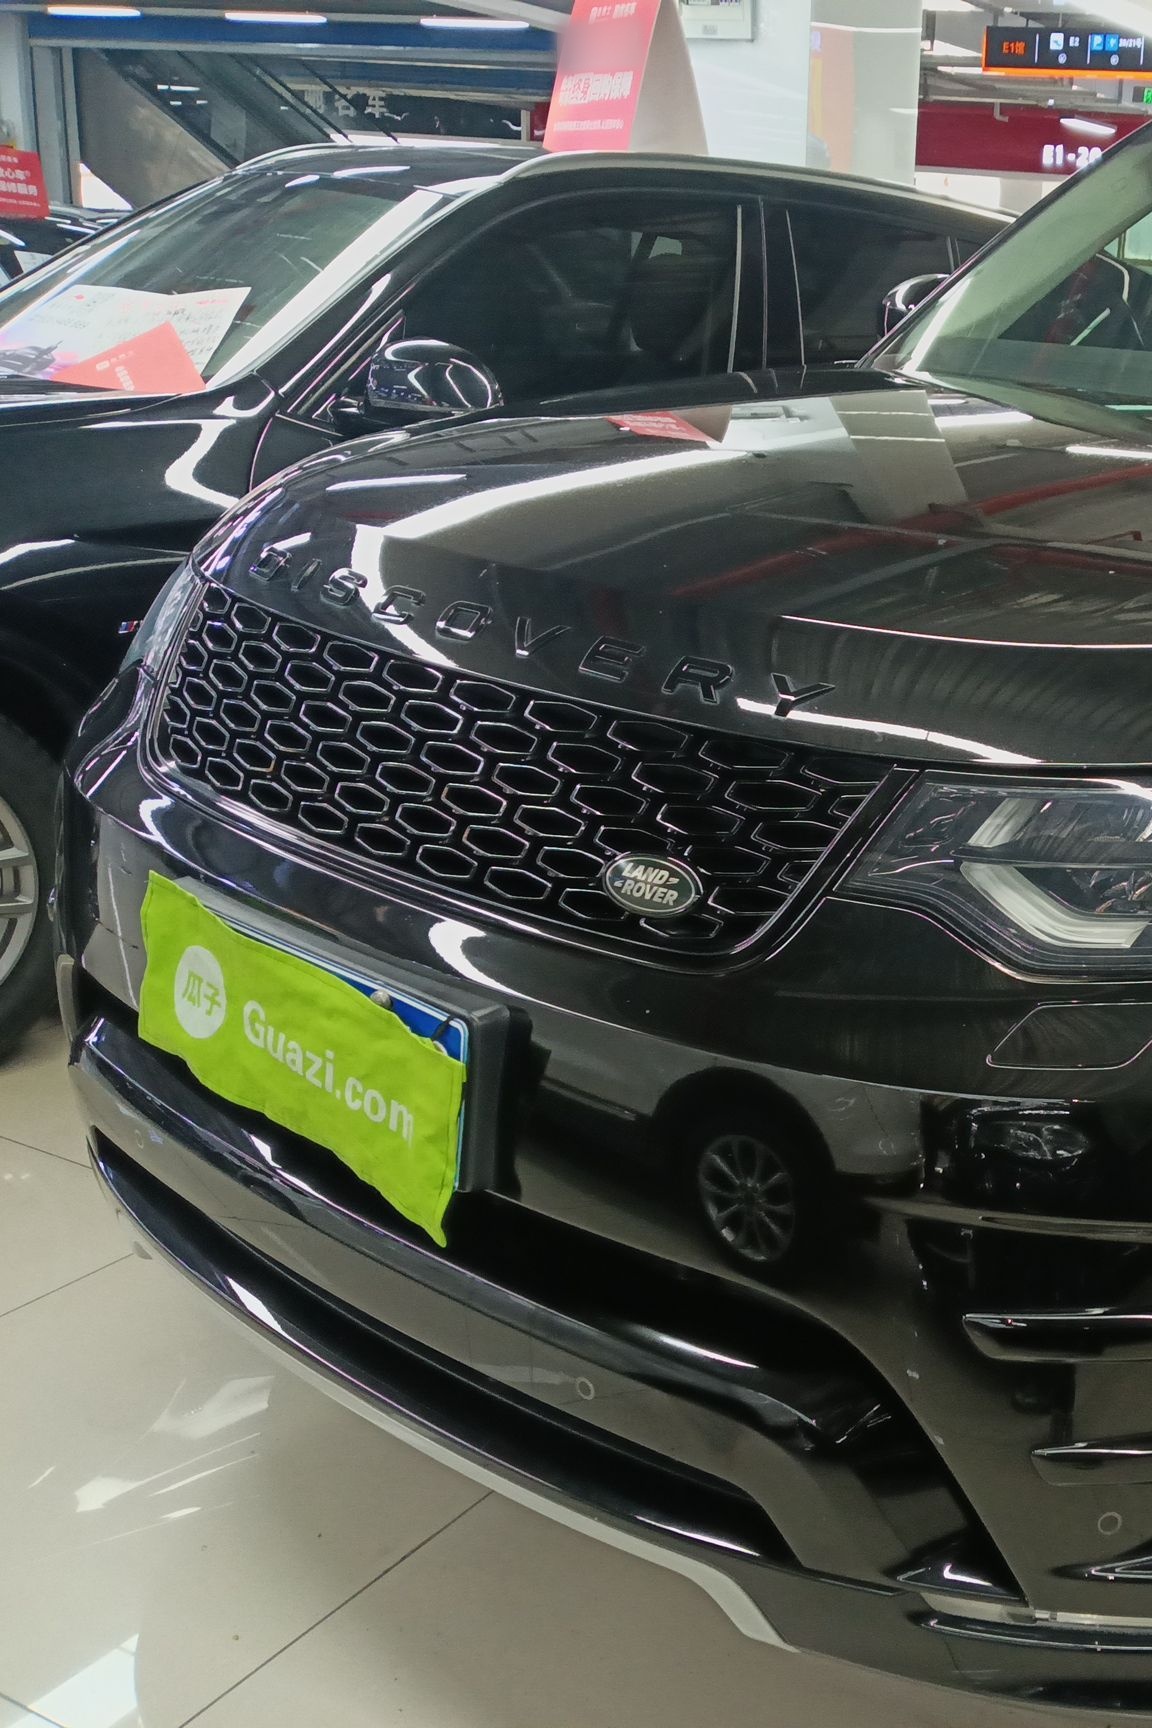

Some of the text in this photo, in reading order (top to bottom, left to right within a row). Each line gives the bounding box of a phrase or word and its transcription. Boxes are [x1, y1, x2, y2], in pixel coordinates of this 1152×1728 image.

[248, 545, 837, 720] DISCOVERY
[621, 862, 670, 885] LAND
[621, 880, 679, 906] ROVER
[183, 970, 223, 1017] 瓜子
[242, 1000, 416, 1149] Guazi.com
